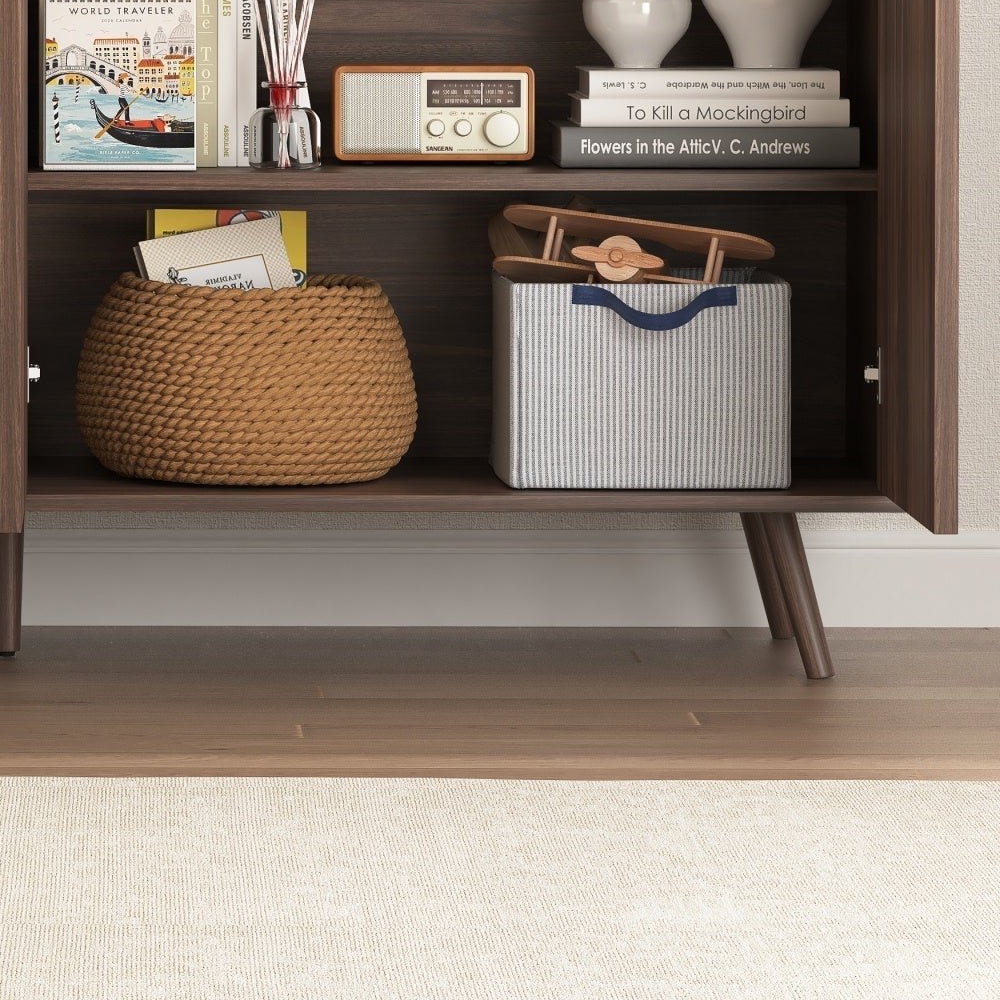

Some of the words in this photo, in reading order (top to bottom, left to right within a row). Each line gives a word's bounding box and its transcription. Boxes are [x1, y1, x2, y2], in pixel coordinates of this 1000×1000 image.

[200, 47, 212, 101] Top
[788, 82, 808, 90] Lion,
[626, 106, 646, 120] To
[652, 106, 673, 120] Kill
[678, 109, 690, 120] a
[696, 106, 806, 124] Mockingbird
[580, 139, 632, 154] Flowers
[636, 139, 648, 154] in
[652, 139, 674, 154] the
[730, 139, 744, 154] C.
[749, 139, 810, 154] Andrews
